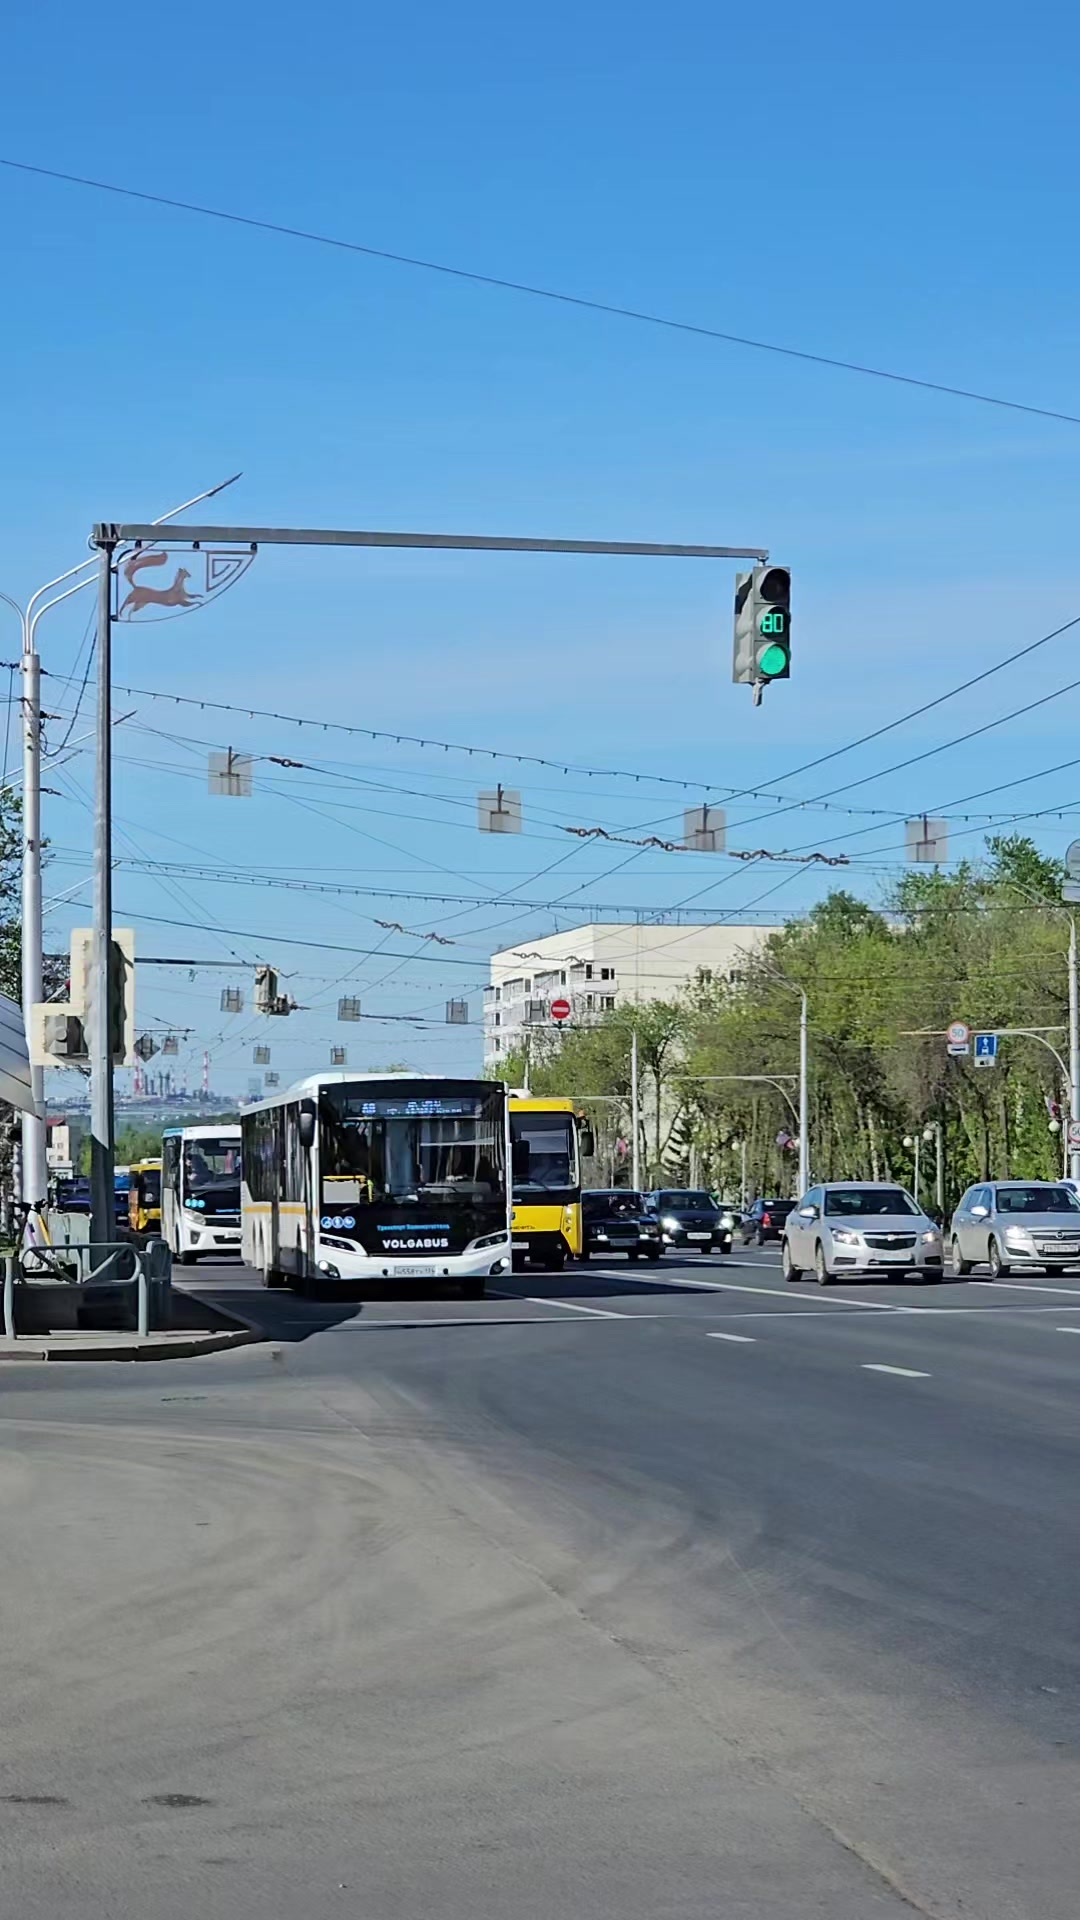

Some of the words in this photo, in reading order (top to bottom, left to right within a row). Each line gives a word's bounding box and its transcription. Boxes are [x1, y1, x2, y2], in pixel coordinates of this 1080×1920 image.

[762, 613, 784, 633] 80
[952, 1028, 965, 1039] 50
[382, 1238, 449, 1249] VOLGABUS
